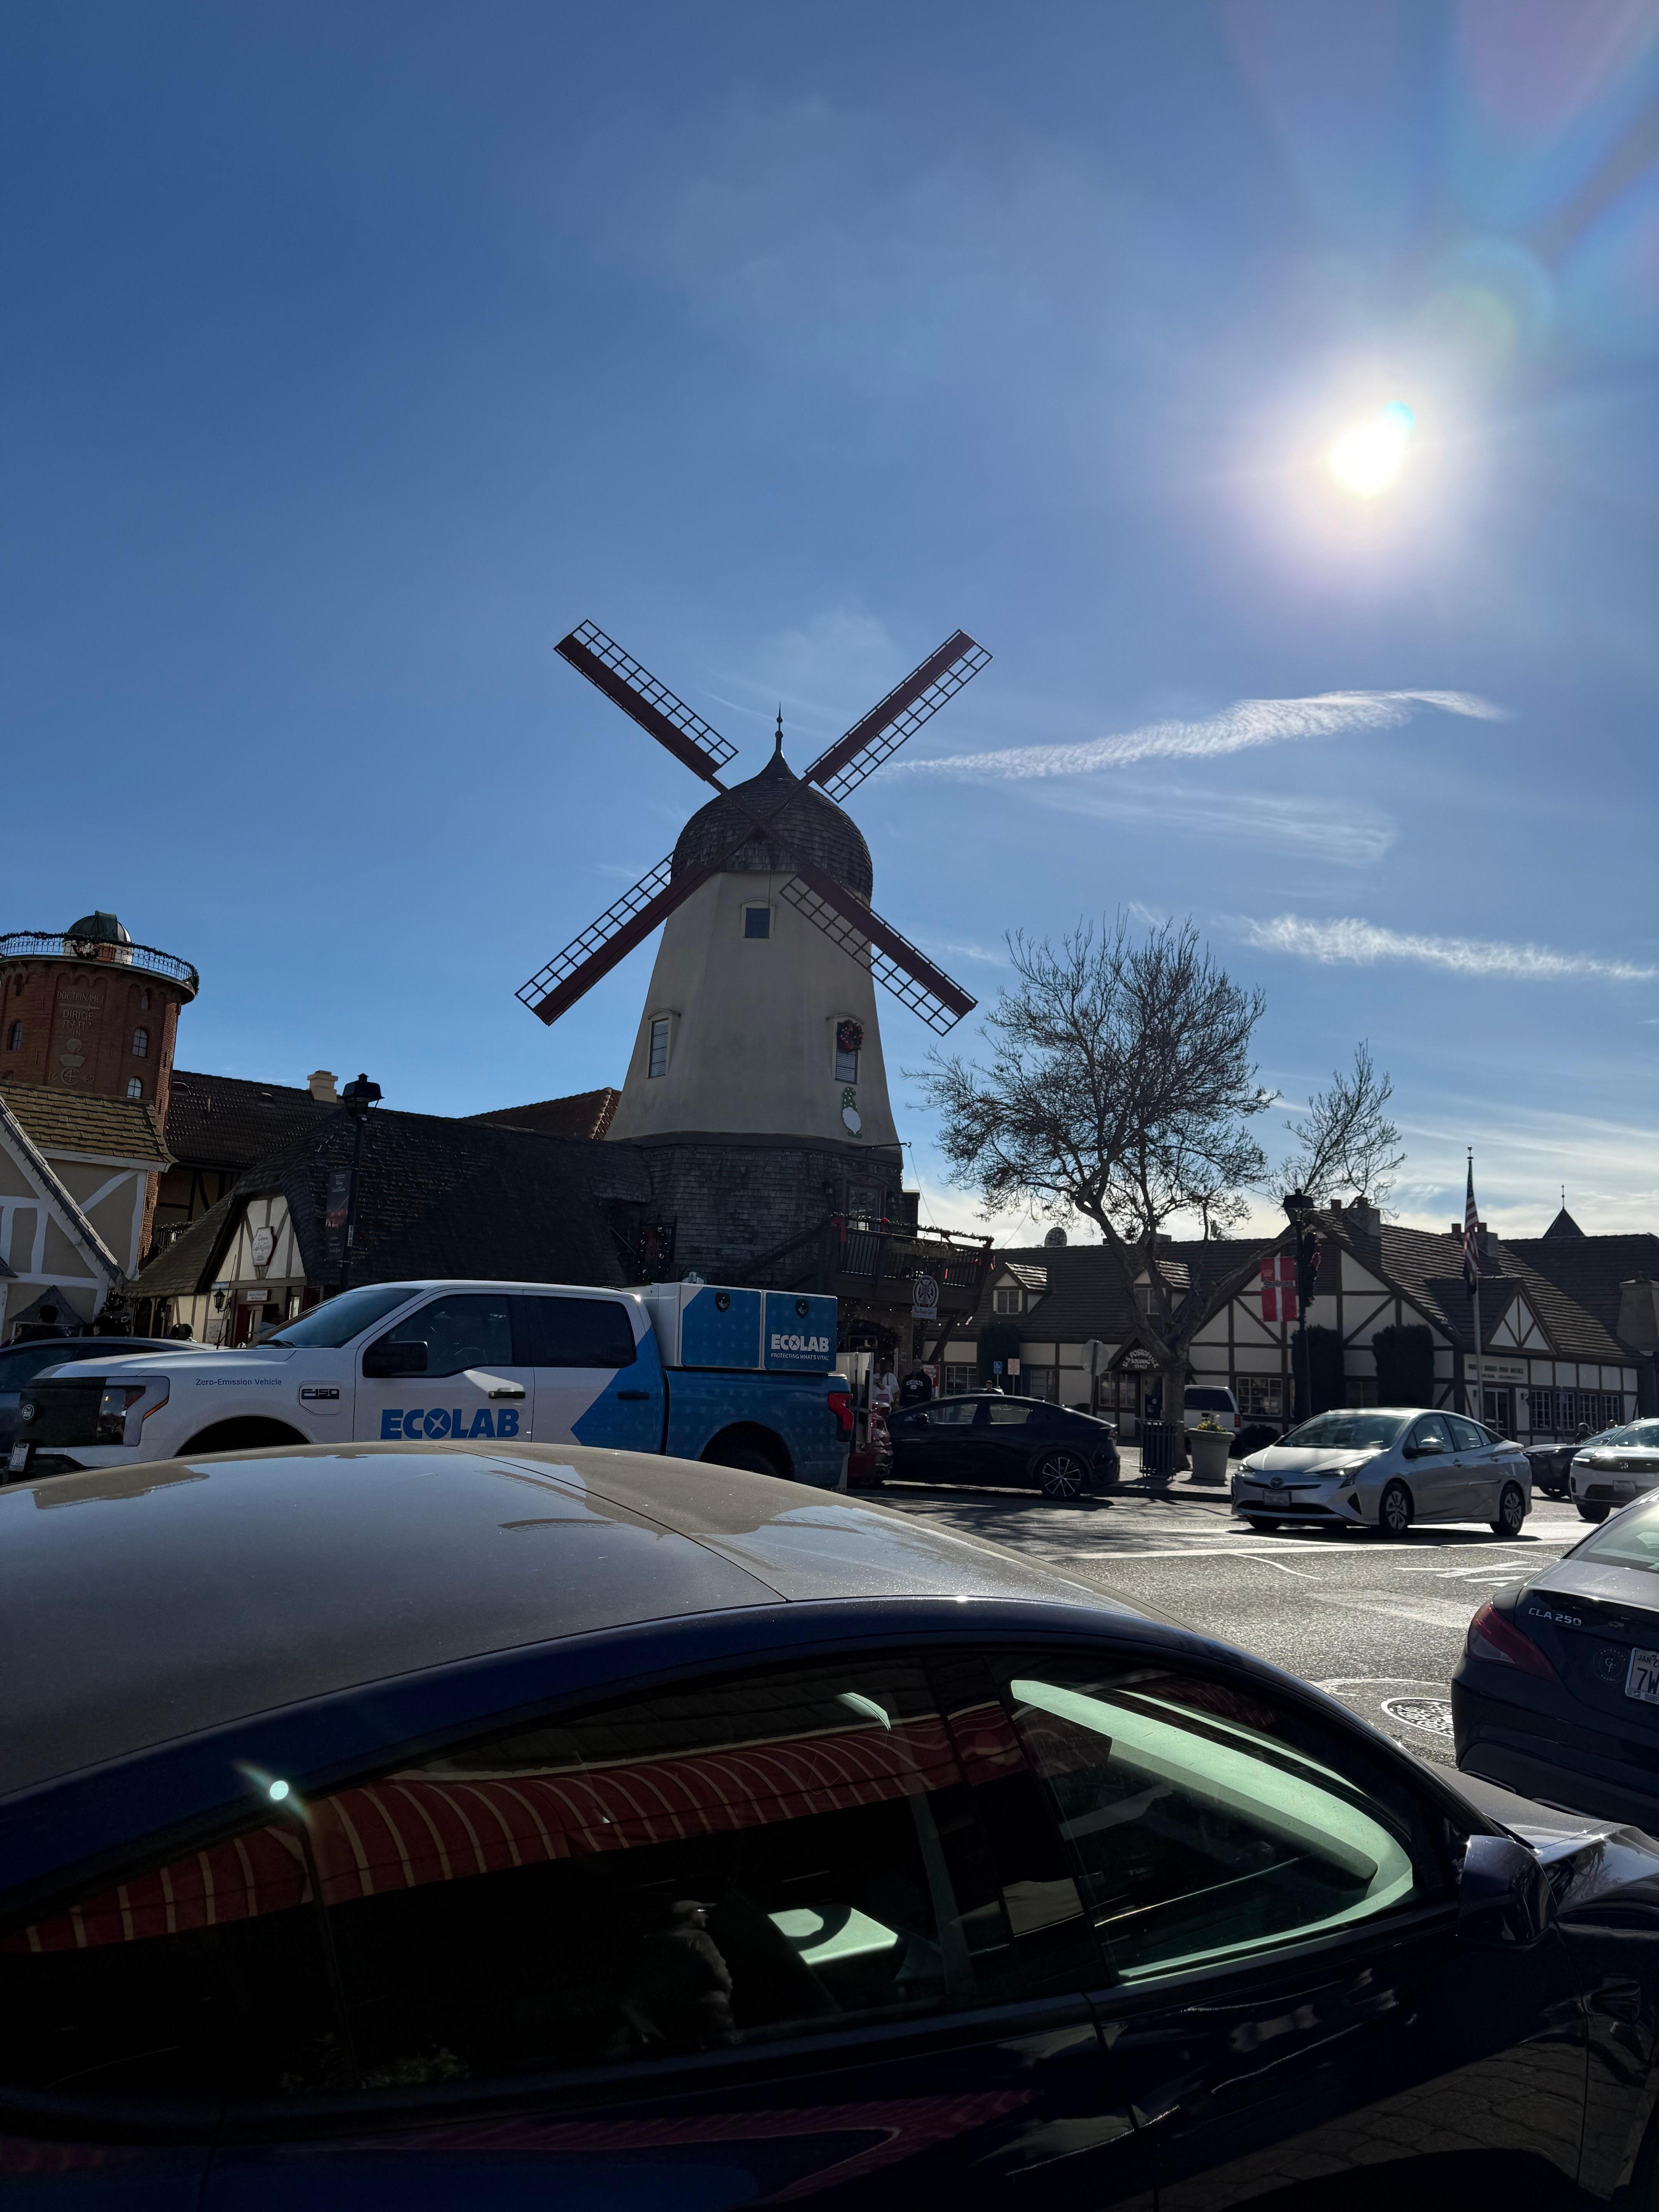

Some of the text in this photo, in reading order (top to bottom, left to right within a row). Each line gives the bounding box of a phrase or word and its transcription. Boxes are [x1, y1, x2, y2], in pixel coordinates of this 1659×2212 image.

[63, 1009, 94, 1021] DIRIGE
[771, 1334, 829, 1352] ECOLAB
[380, 1408, 519, 1439] ECOLAB
[1528, 1607, 1582, 1627] CLA 250
[1638, 1655, 1652, 1664] JAN
